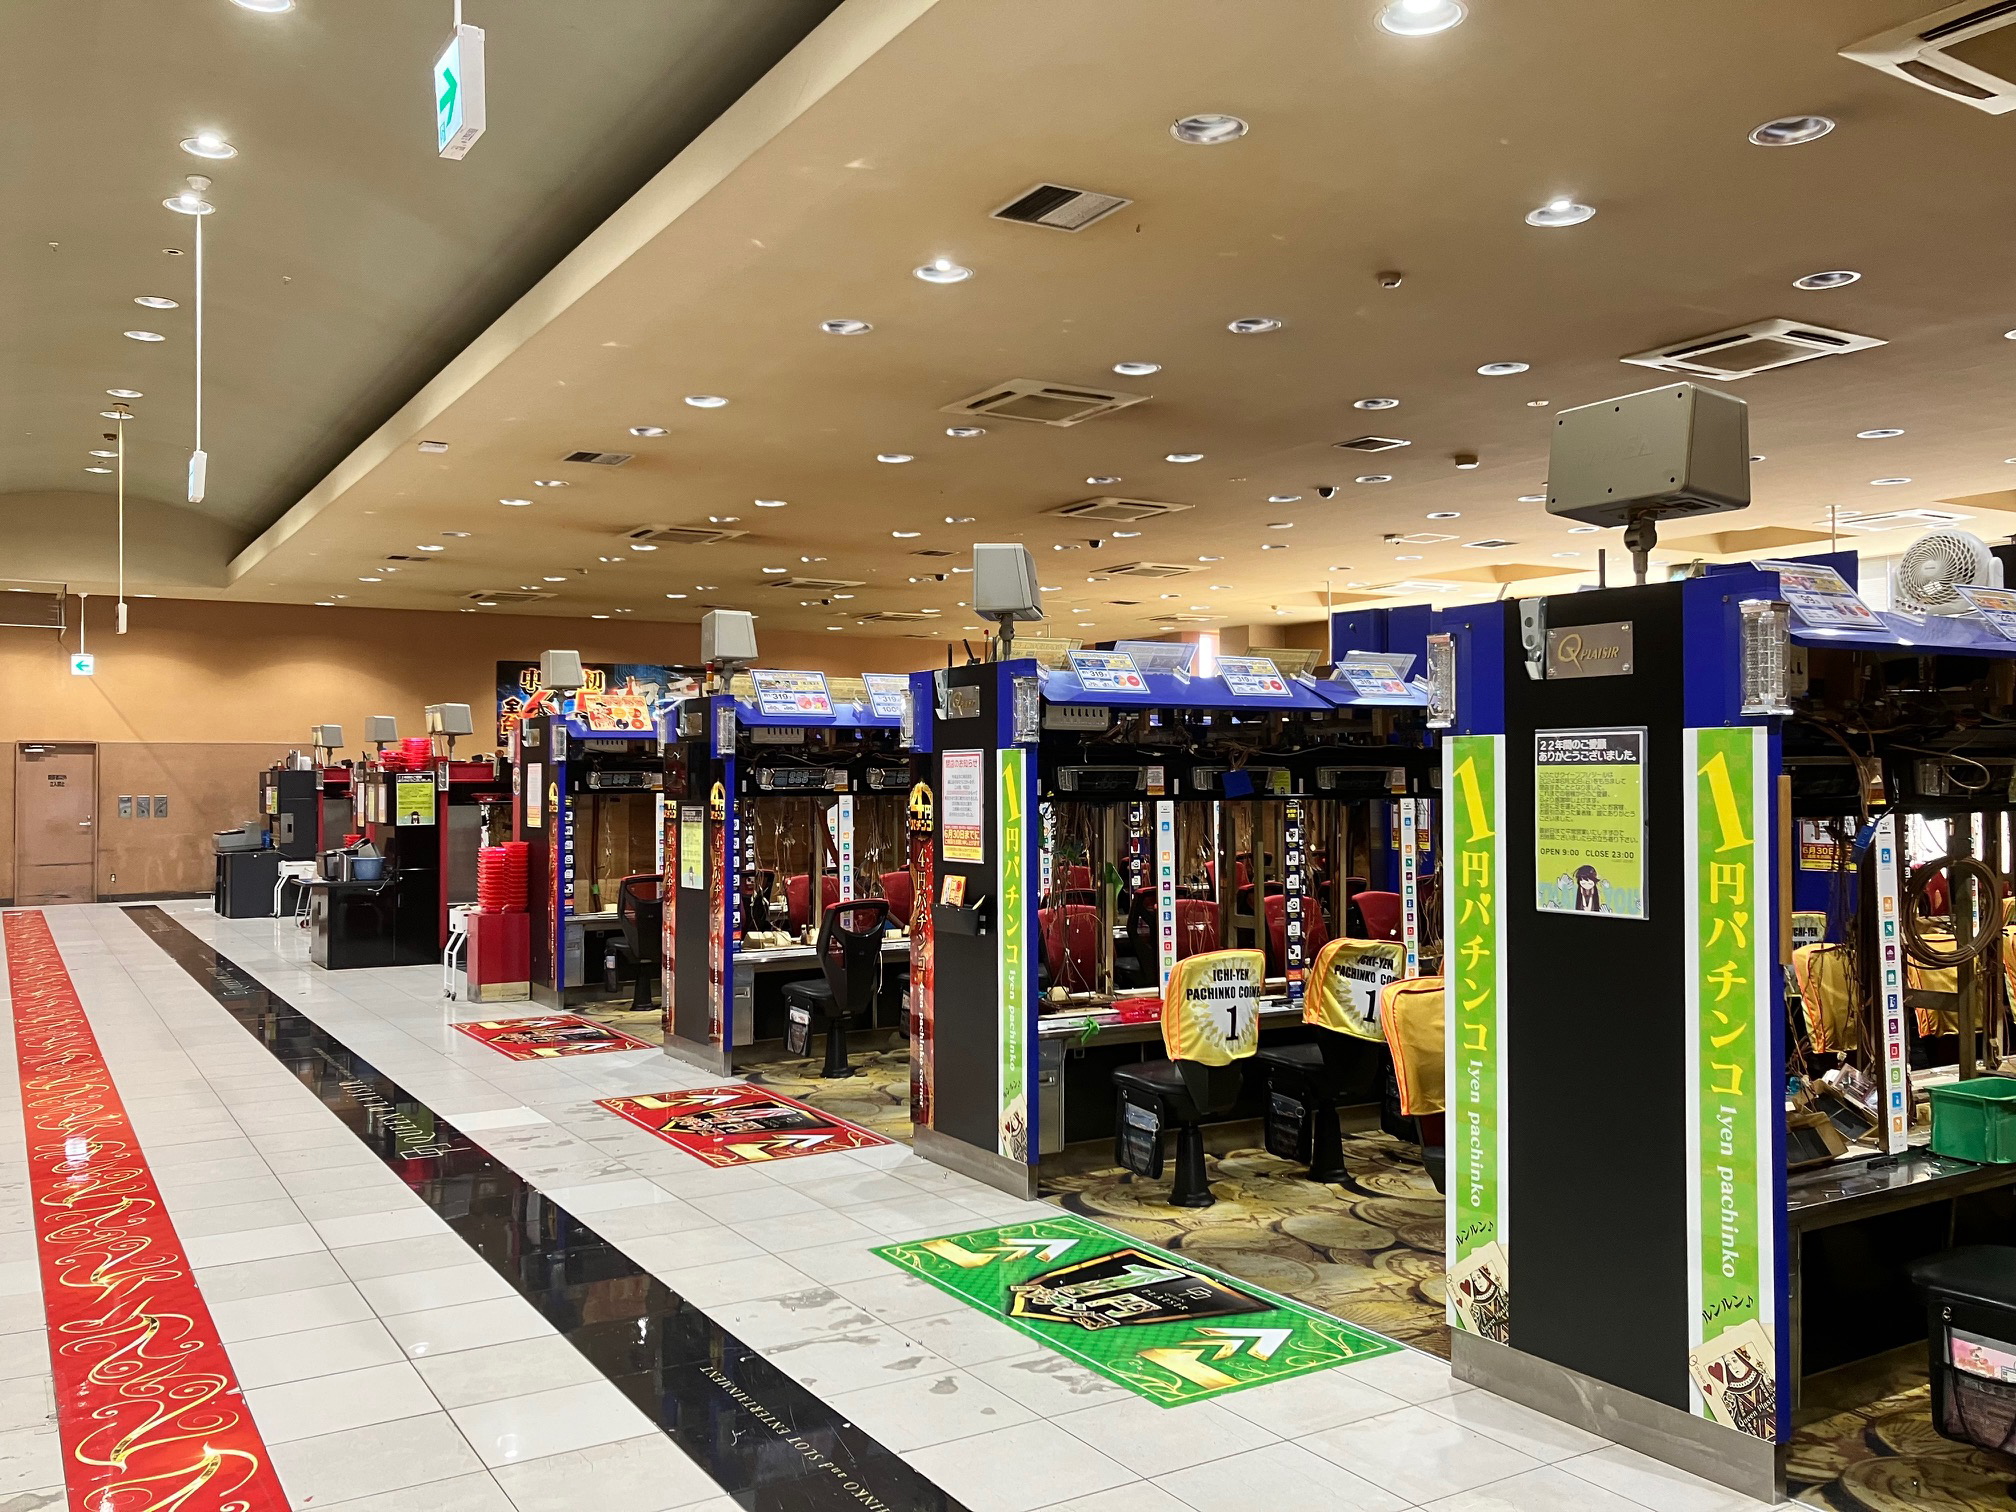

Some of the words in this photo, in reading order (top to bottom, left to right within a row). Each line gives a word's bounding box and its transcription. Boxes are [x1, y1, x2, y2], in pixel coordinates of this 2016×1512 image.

[1581, 646, 1619, 661] PLAISIR
[1538, 750, 1637, 762] ありがとうございました。
[1001, 762, 1022, 964] 1円パチンコ
[1540, 848, 1560, 856] OPEN
[1562, 848, 1580, 857] 9:00
[1585, 849, 1609, 858] CLOSE
[1611, 851, 1635, 859] 23:00
[915, 847, 927, 972] 4円パチンコ
[1452, 755, 1496, 1052] 1円パチンコ
[1697, 751, 1756, 1096] 1円パチンコ
[1792, 926, 1818, 937] CHI-YEN
[1212, 968, 1250, 982] ICHI-YEN
[1333, 964, 1377, 984] PACHINKO
[1356, 954, 1395, 971] ICHI-YEN
[1186, 986, 1236, 1001] PACHINKO
[1362, 989, 1378, 1024] 1
[917, 1012, 925, 1065] pachinko
[1007, 1004, 1017, 1072] pachinko
[1225, 1005, 1239, 1042] 1
[917, 1069, 925, 1108] corner
[1467, 1110, 1484, 1208] pachinko
[1716, 1162, 1738, 1279] pachinko
[699, 1365, 792, 1436] ENTERTAINMENT
[785, 1436, 824, 1461] SLOT
[818, 1461, 848, 1479] and
